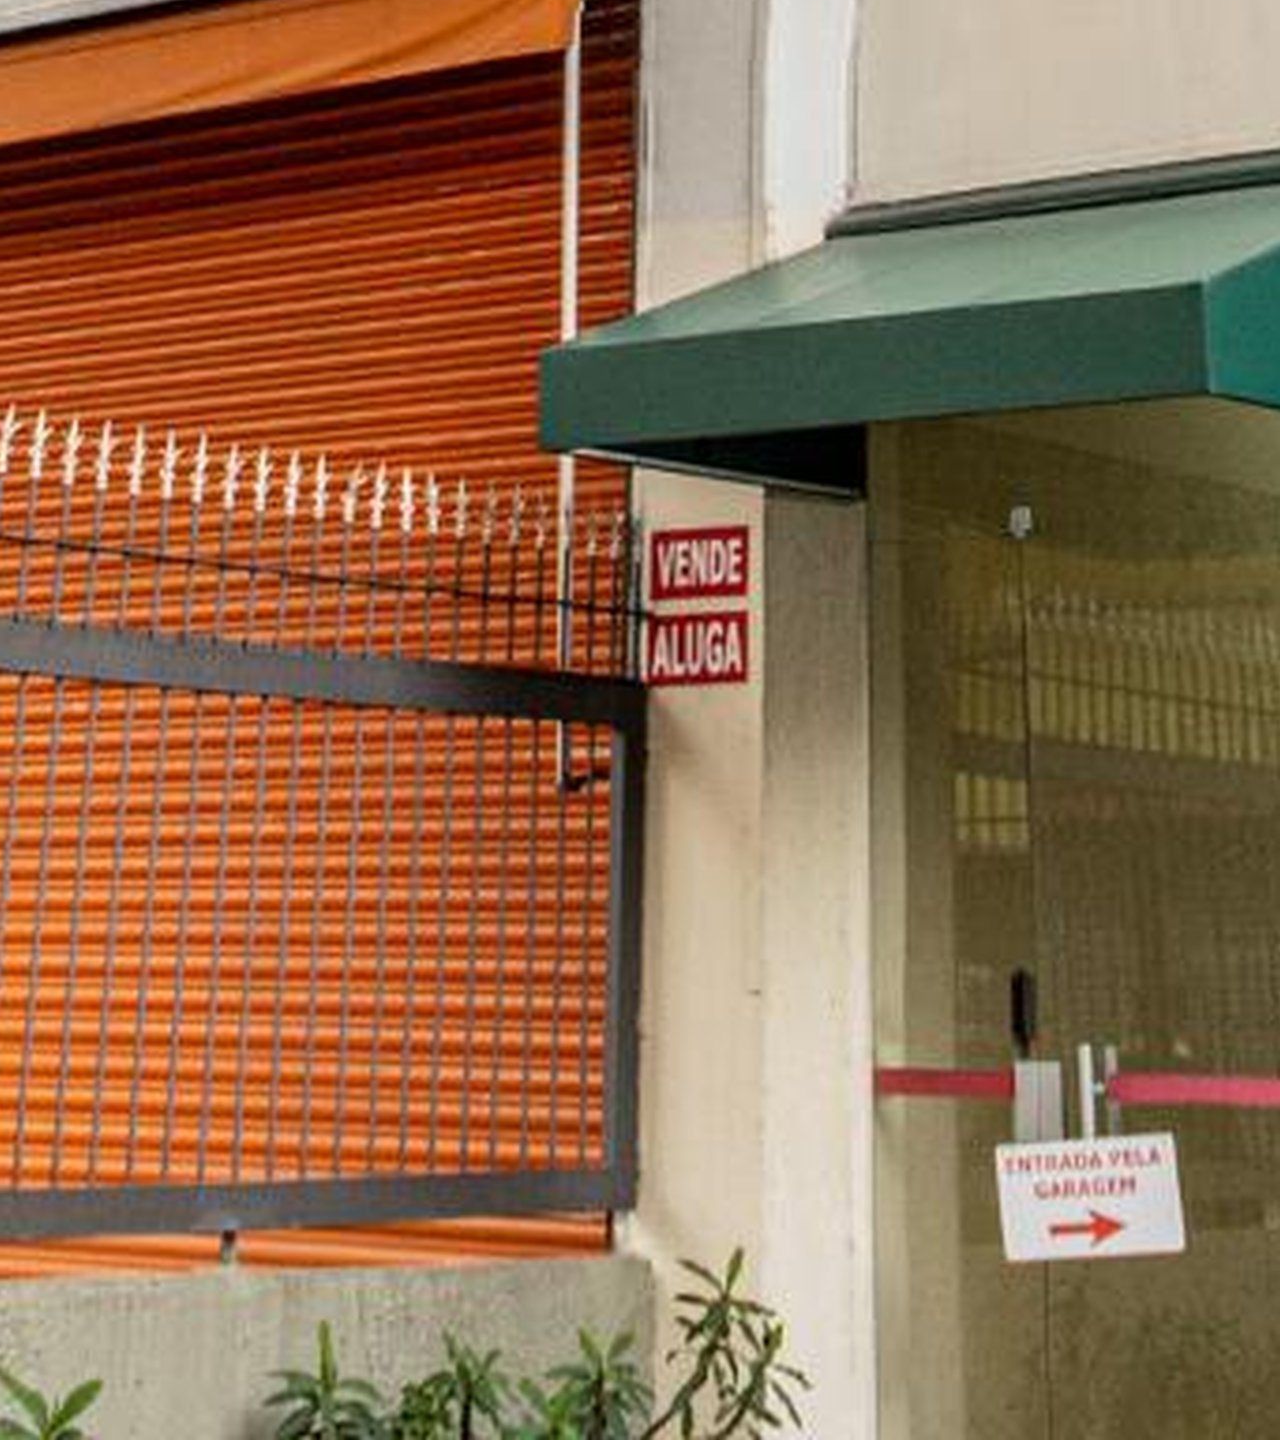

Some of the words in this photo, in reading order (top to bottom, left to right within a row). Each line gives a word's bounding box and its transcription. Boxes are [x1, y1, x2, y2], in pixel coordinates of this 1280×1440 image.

[656, 536, 744, 590] VENDE
[651, 619, 744, 677] ALUGA
[1004, 1151, 1103, 1174] ENTRADA
[1033, 1175, 1137, 1200] GARAGEM
